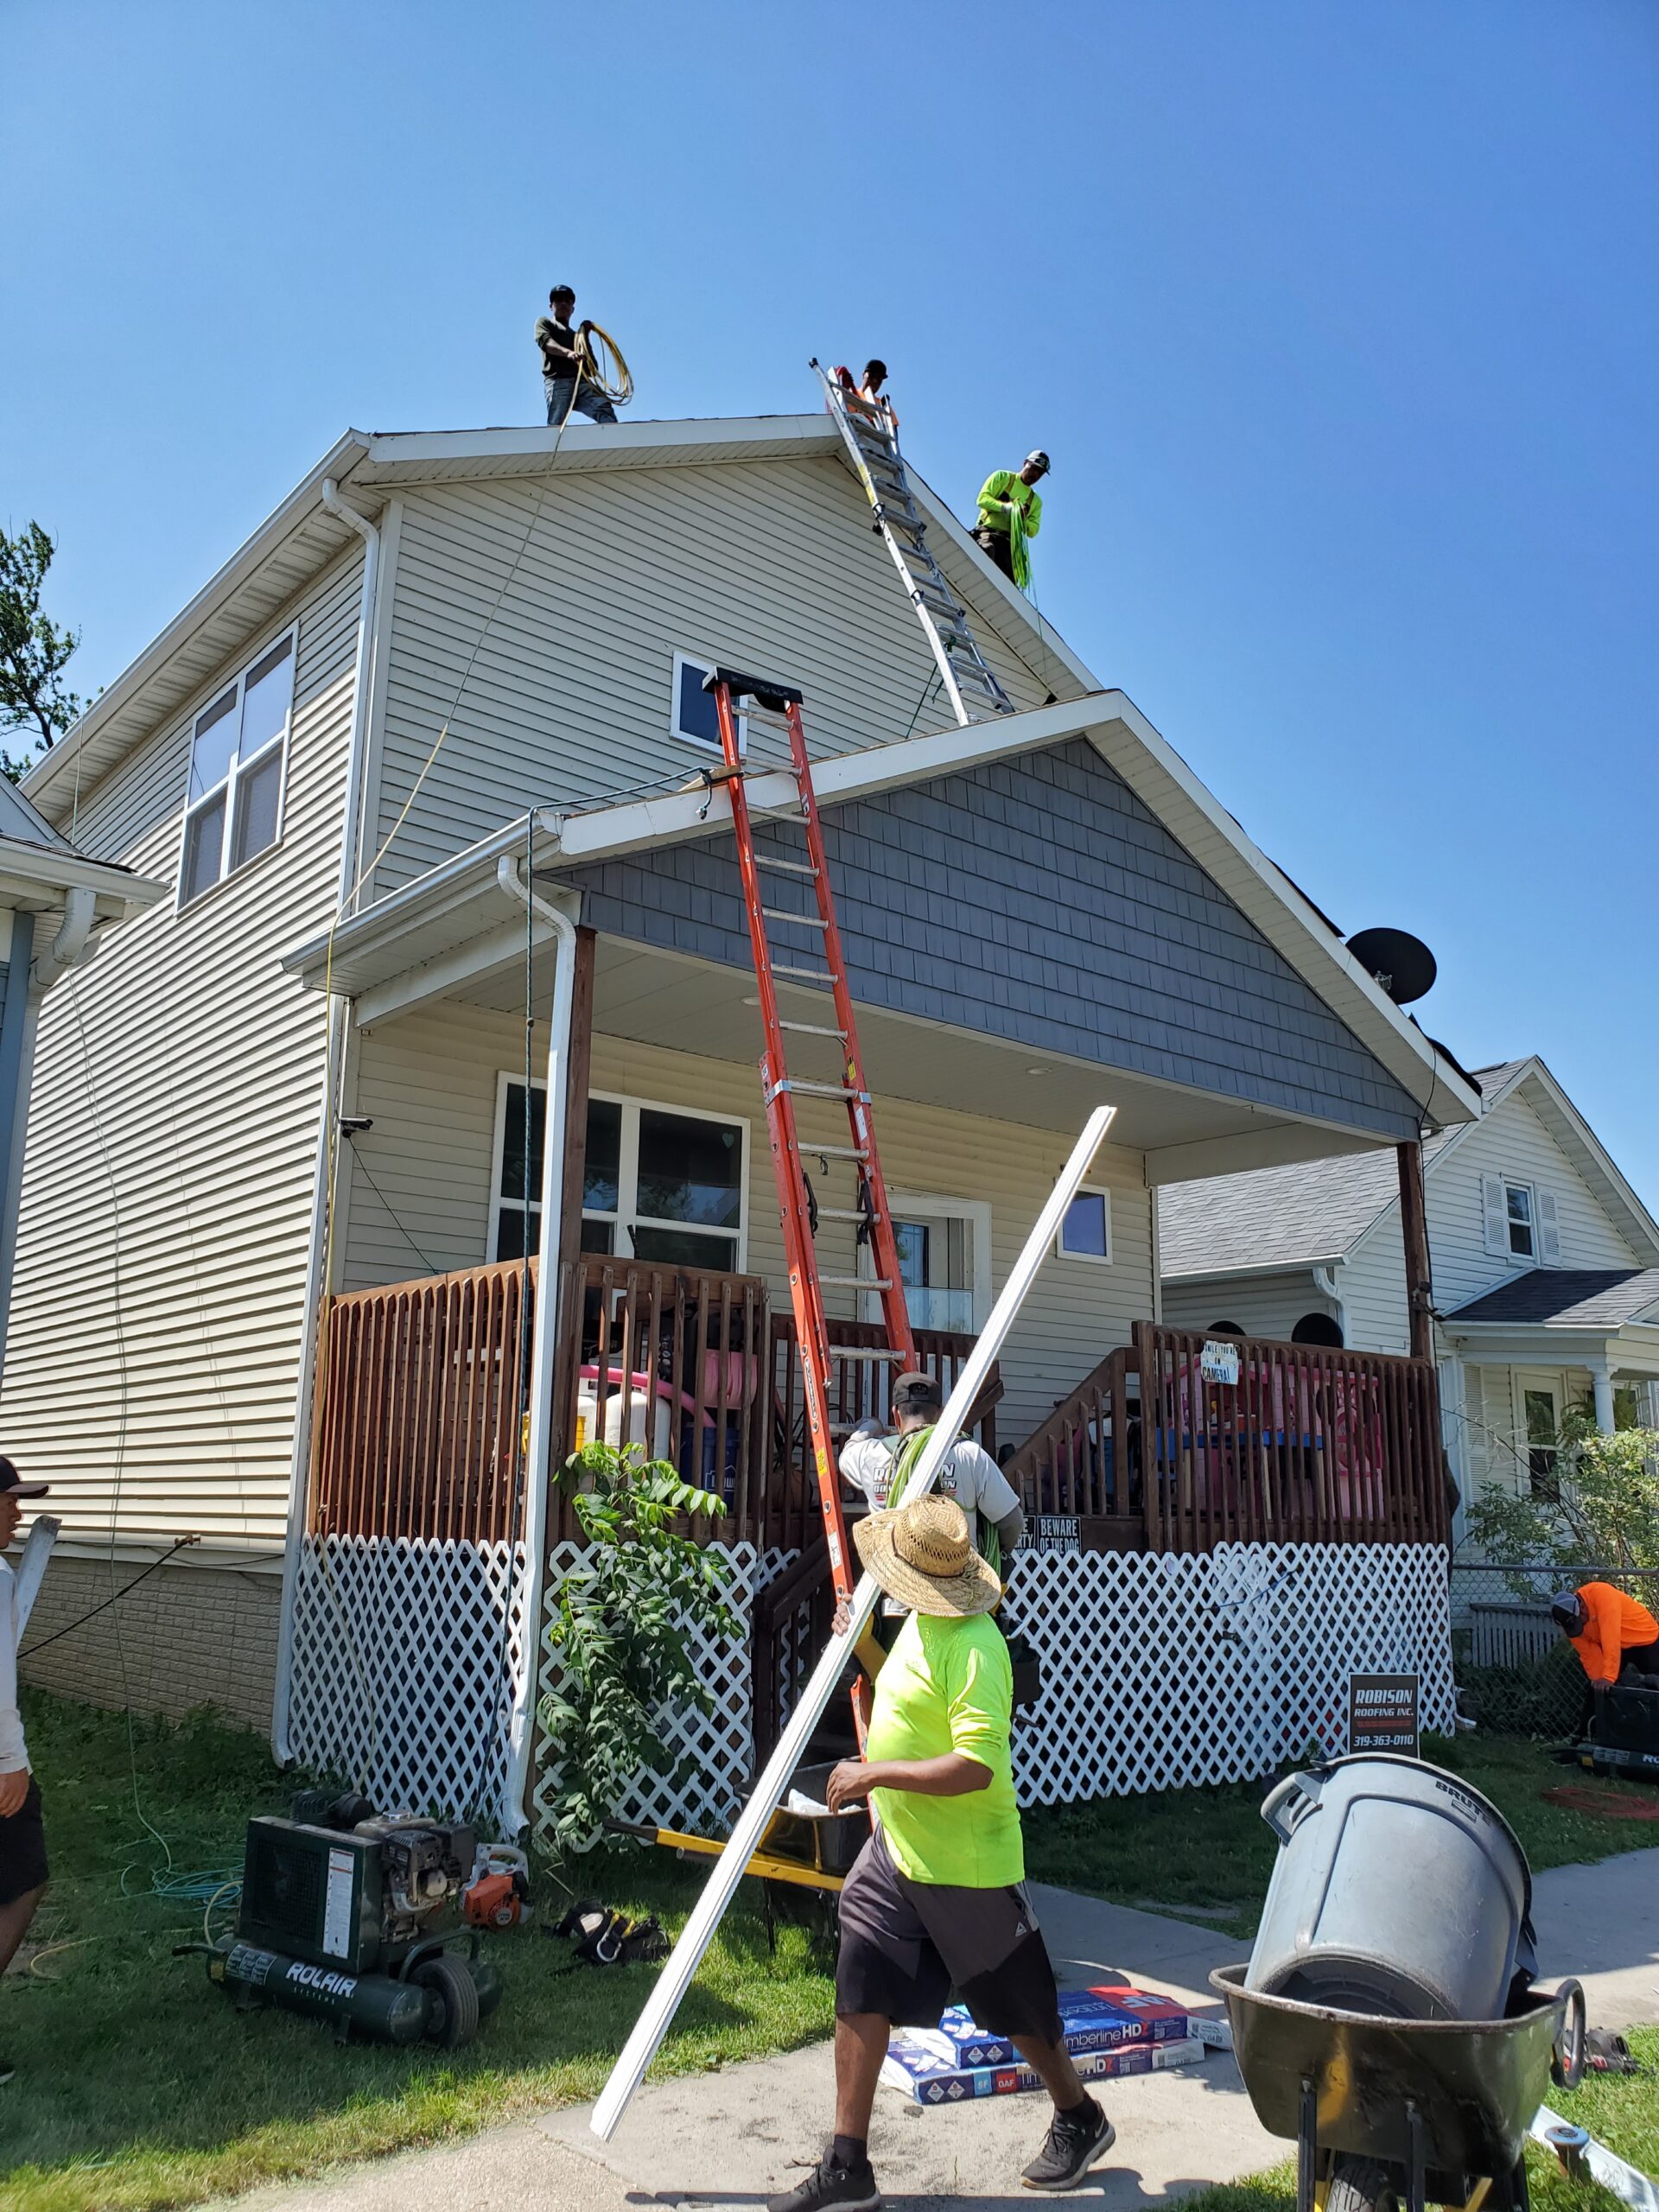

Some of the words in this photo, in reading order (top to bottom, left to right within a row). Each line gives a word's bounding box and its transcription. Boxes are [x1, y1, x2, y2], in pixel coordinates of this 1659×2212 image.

[1215, 1357, 1221, 1365] ON
[1202, 1367, 1230, 1382] CAMERA!
[1040, 1518, 1077, 1537] BEWARE
[1039, 1537, 1049, 1554] OF
[1050, 1537, 1065, 1554] THE
[1065, 1538, 1080, 1554] DOG
[1355, 1689, 1413, 1704] ROBISON
[1354, 1707, 1395, 1717] ROOFING
[1396, 1707, 1414, 1717] INC.
[1353, 1734, 1414, 1747] 319-363-0110
[1435, 1780, 1492, 1827] BRUTE
[285, 1961, 358, 1999] ROLAIR
[1064, 2030, 1122, 2048] imberline
[998, 2079, 1014, 2088] GAF
